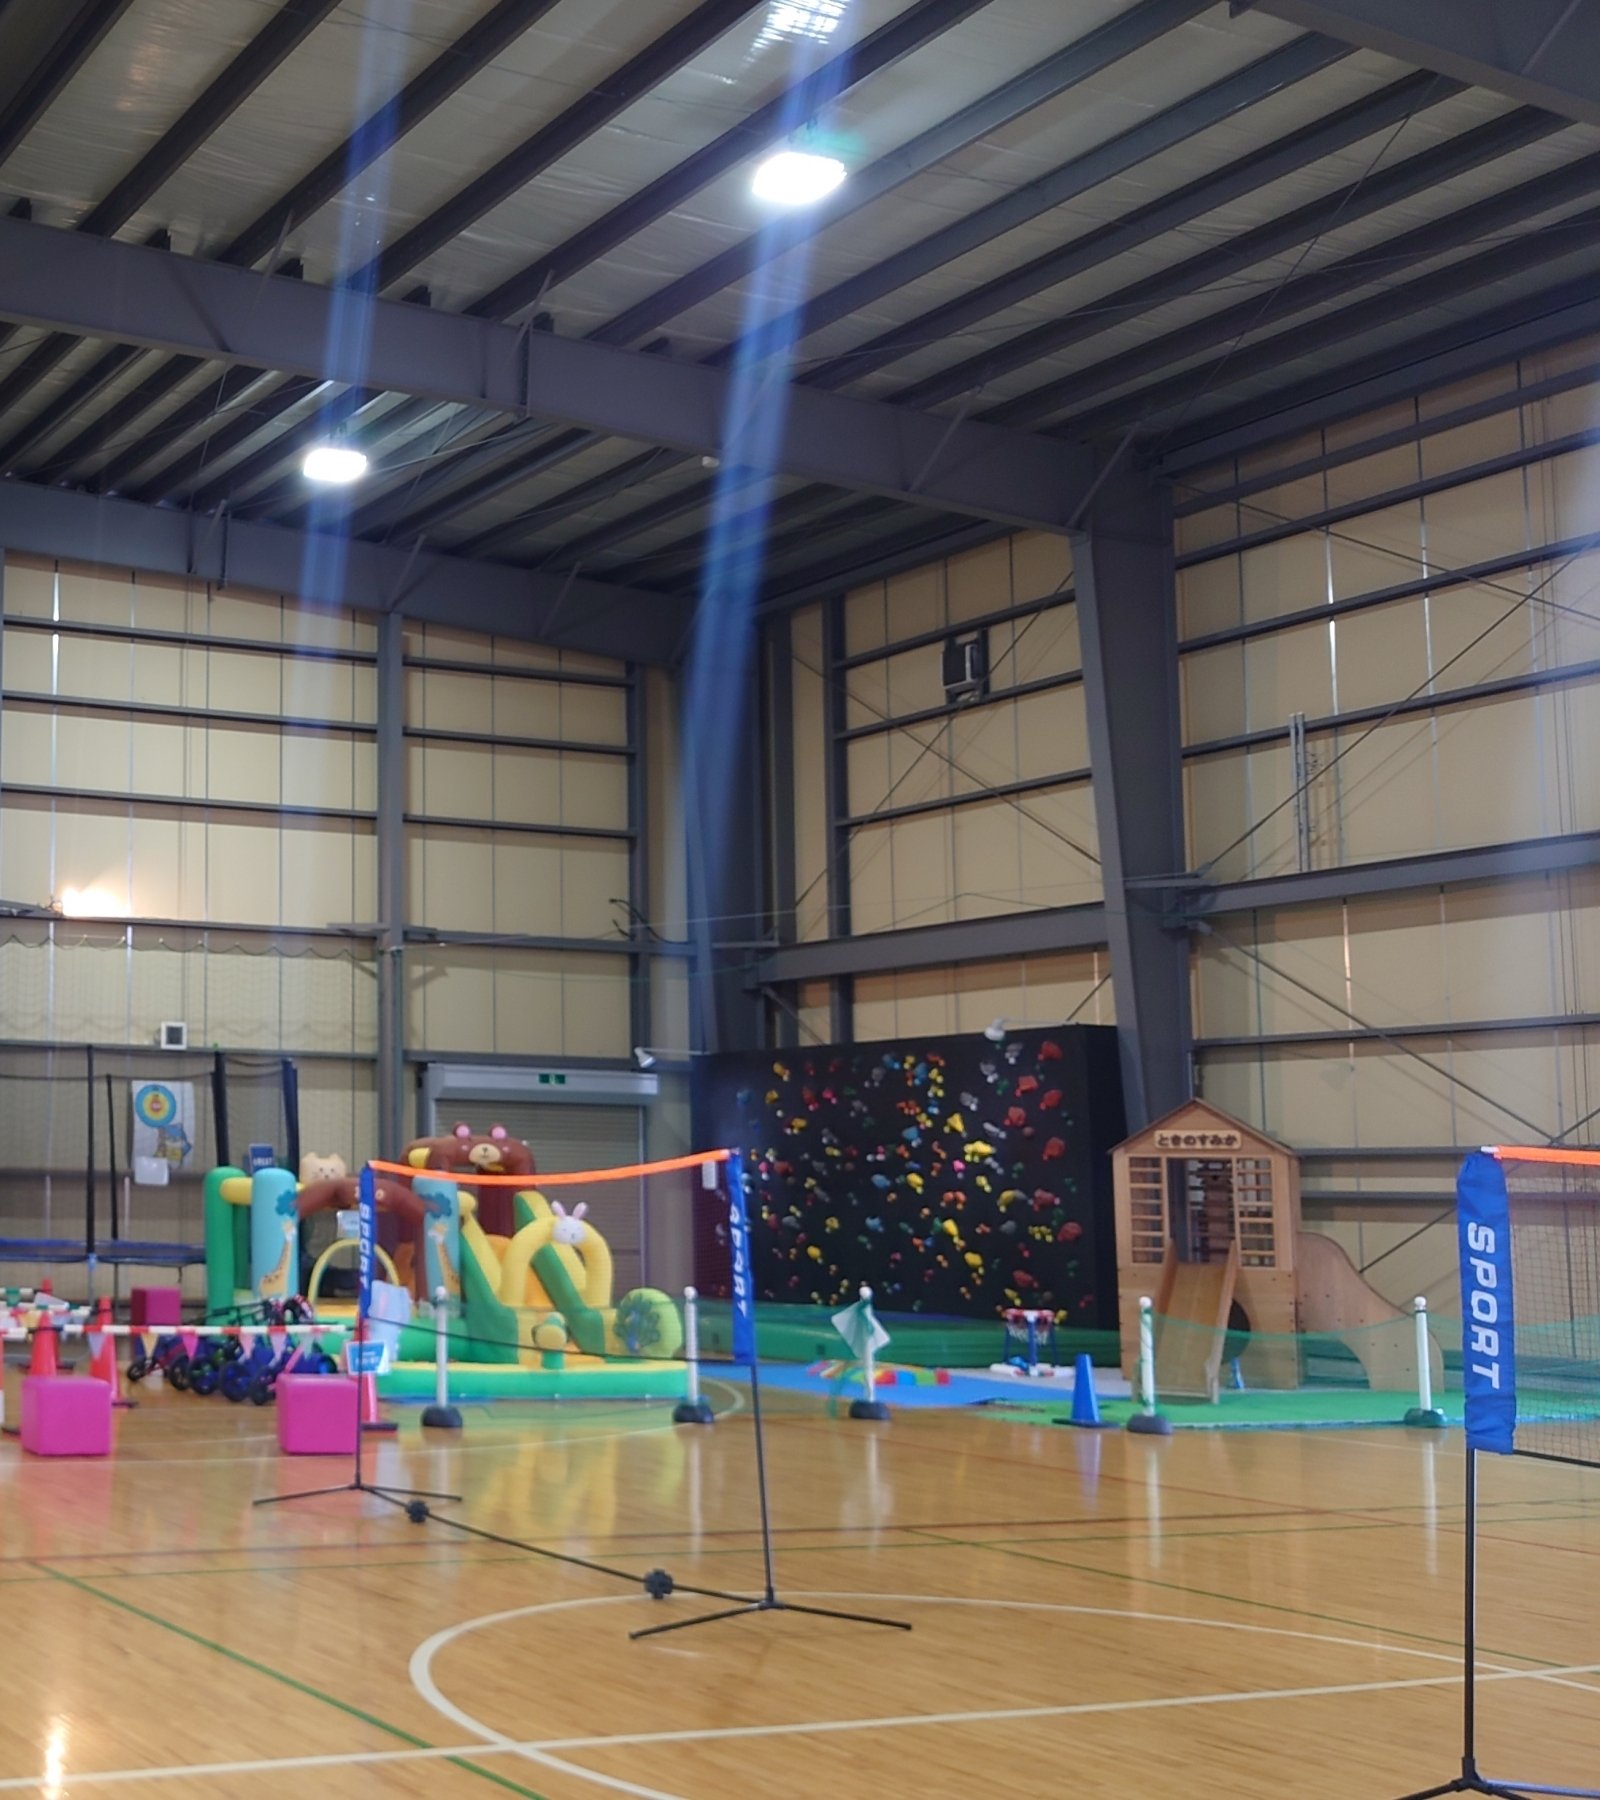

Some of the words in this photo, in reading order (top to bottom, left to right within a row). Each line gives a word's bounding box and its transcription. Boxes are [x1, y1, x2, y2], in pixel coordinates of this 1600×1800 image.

[1157, 1132, 1238, 1147] ときのすみか
[359, 1202, 371, 1290] SPORT
[729, 1202, 748, 1318] SPORT
[1467, 1221, 1501, 1390] SPORT
